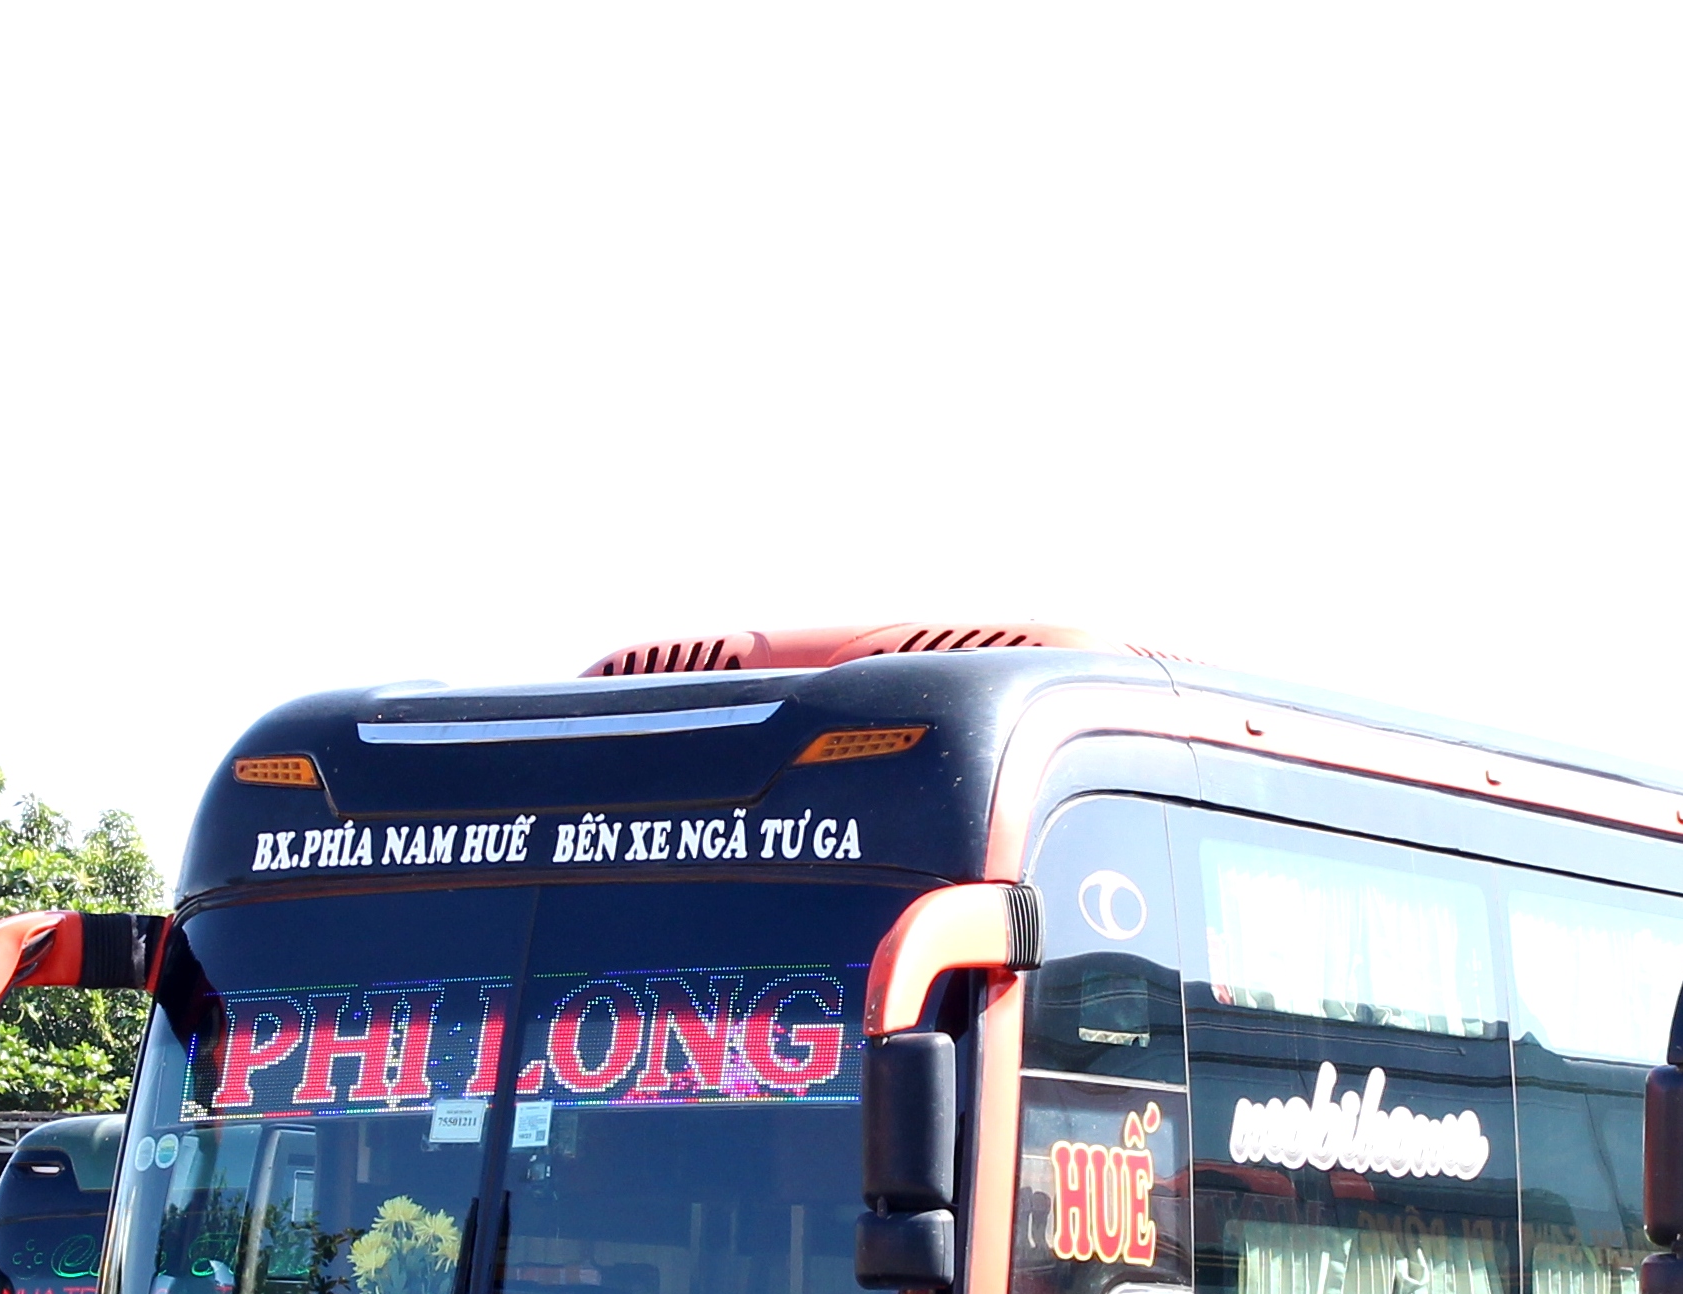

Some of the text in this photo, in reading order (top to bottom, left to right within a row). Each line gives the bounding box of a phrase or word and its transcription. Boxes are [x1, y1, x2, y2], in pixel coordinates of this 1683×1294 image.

[380, 824, 466, 866] NAM
[462, 815, 537, 864] HUẾ
[552, 814, 621, 863] BẾN
[624, 821, 670, 861] XE
[676, 809, 748, 860] NGÃ
[759, 808, 813, 859] TƯ
[813, 818, 863, 861] GA
[211, 972, 845, 1110] PHI LONG
[1051, 1101, 1161, 1267] HUẾ
